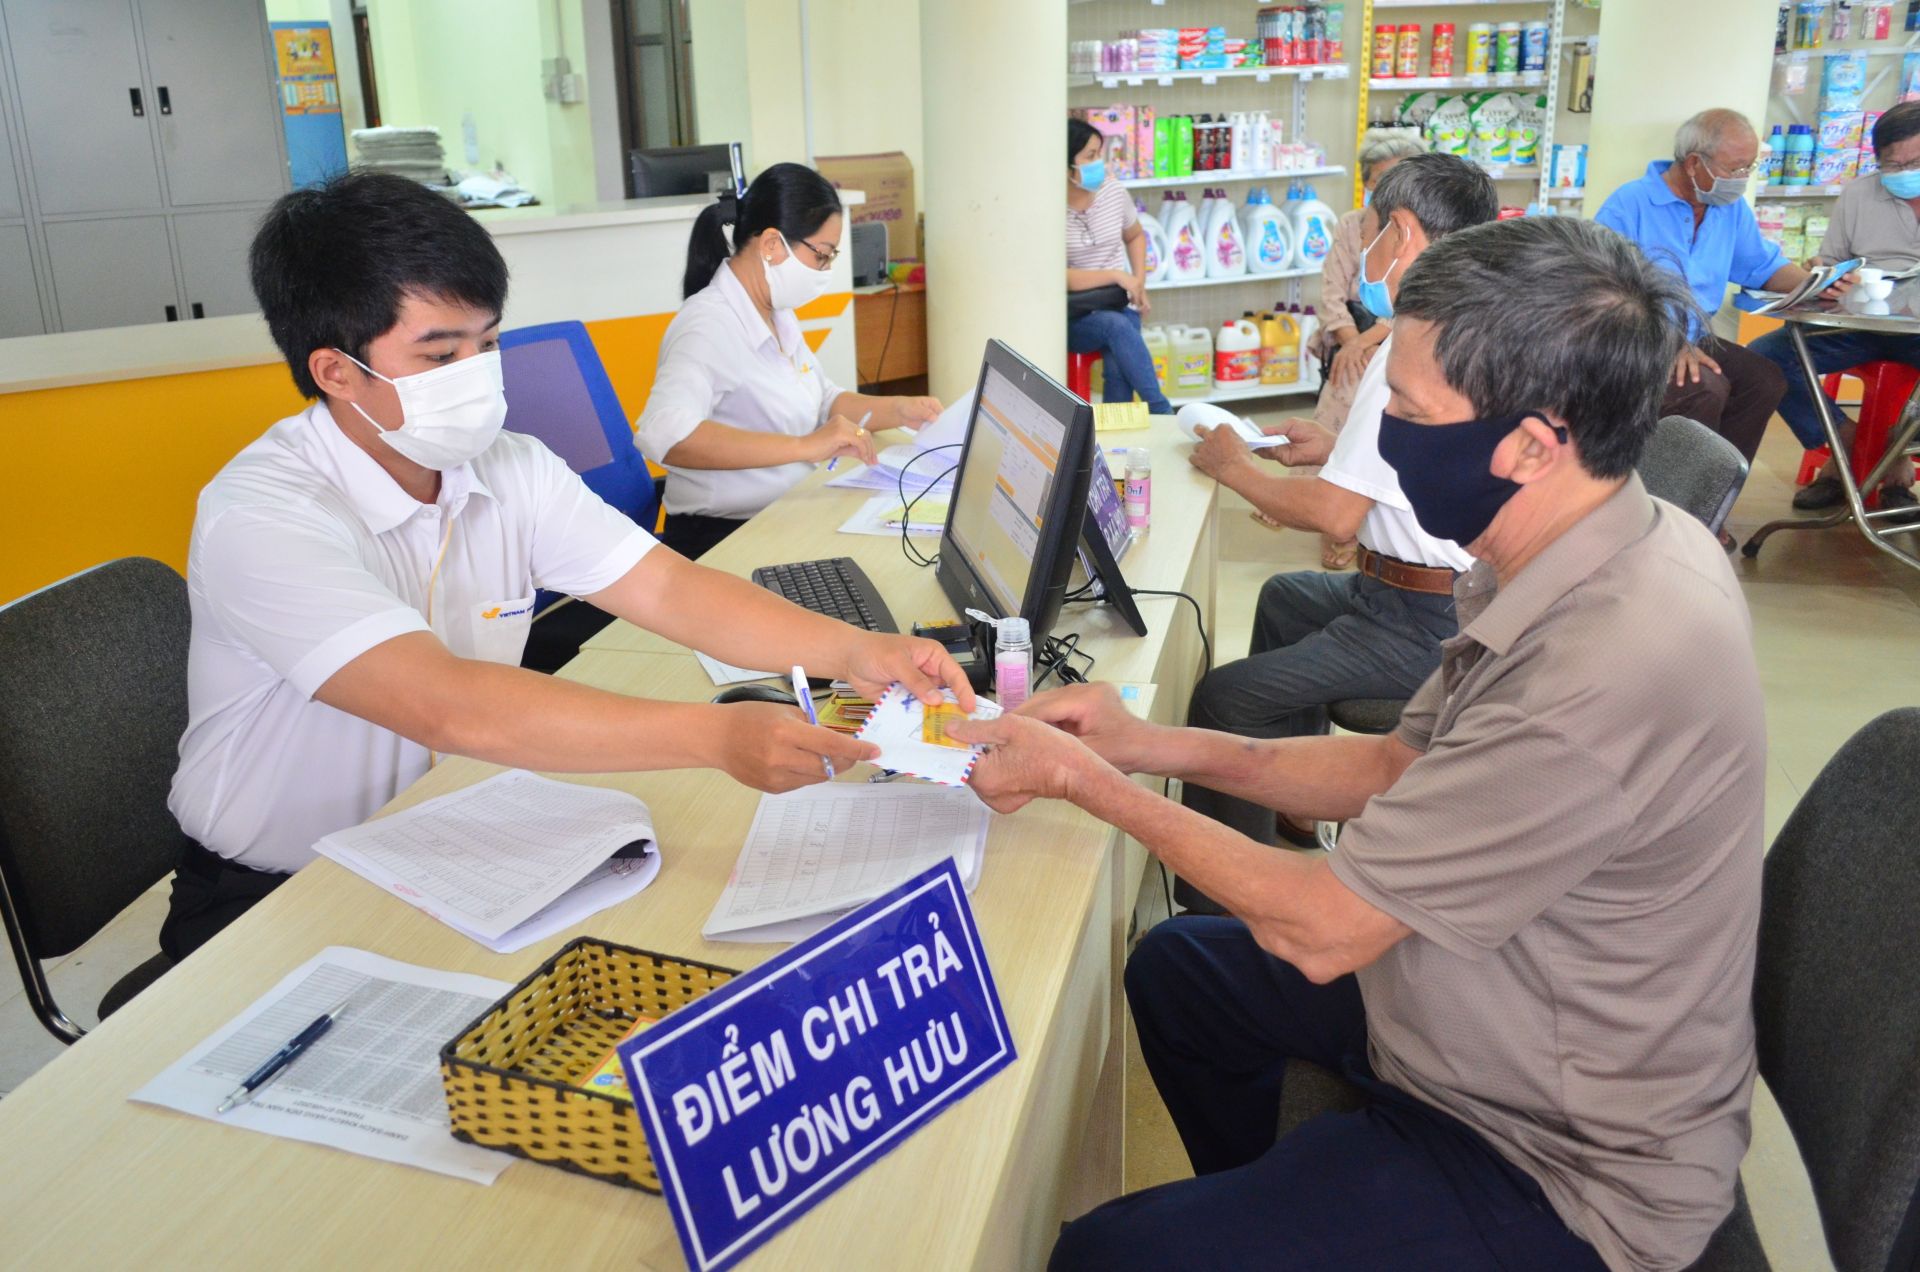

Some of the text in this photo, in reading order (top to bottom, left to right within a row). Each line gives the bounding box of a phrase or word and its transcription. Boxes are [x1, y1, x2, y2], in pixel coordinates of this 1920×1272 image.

[671, 911, 963, 1147] ĐIỂM CHI TRẢ
[722, 1012, 969, 1221] LƯƠNG HƯU
